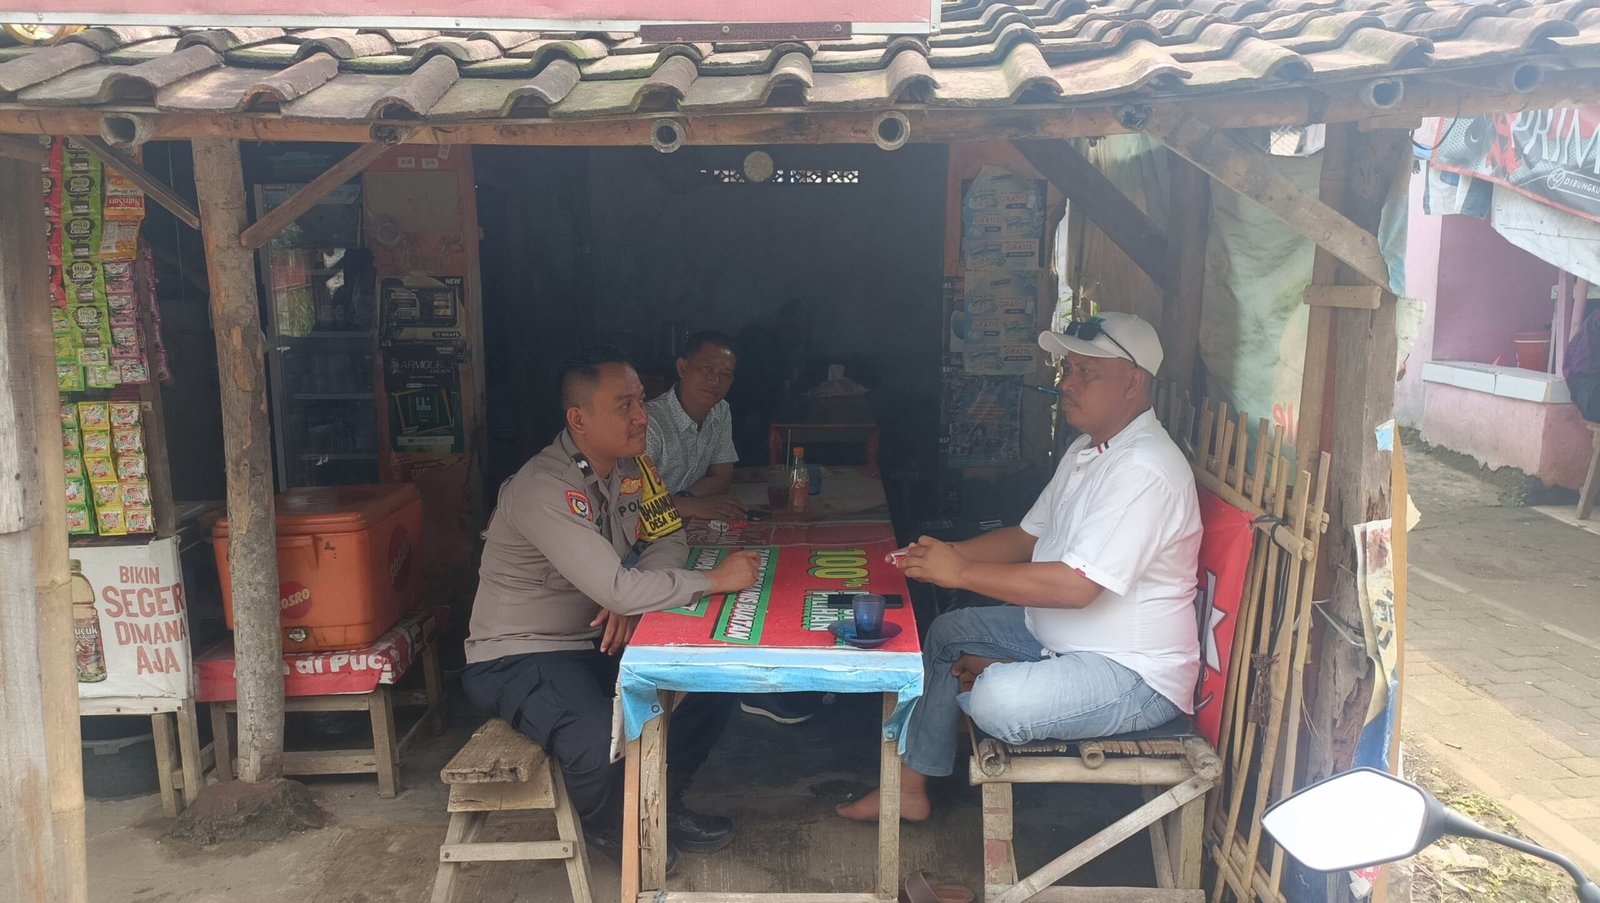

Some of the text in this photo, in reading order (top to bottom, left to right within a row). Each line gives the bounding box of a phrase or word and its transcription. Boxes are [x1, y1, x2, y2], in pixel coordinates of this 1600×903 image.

[649, 516, 669, 531] DESA
[694, 549, 719, 570] TANPA
[812, 549, 871, 588] 100%
[119, 565, 160, 585] BIKIN
[102, 583, 185, 618] SEGER
[279, 588, 310, 609] OSRO
[74, 625, 98, 635] ucuk
[114, 617, 187, 646] DIMANA
[725, 604, 756, 640] BUATAN
[137, 646, 181, 675] AJA
